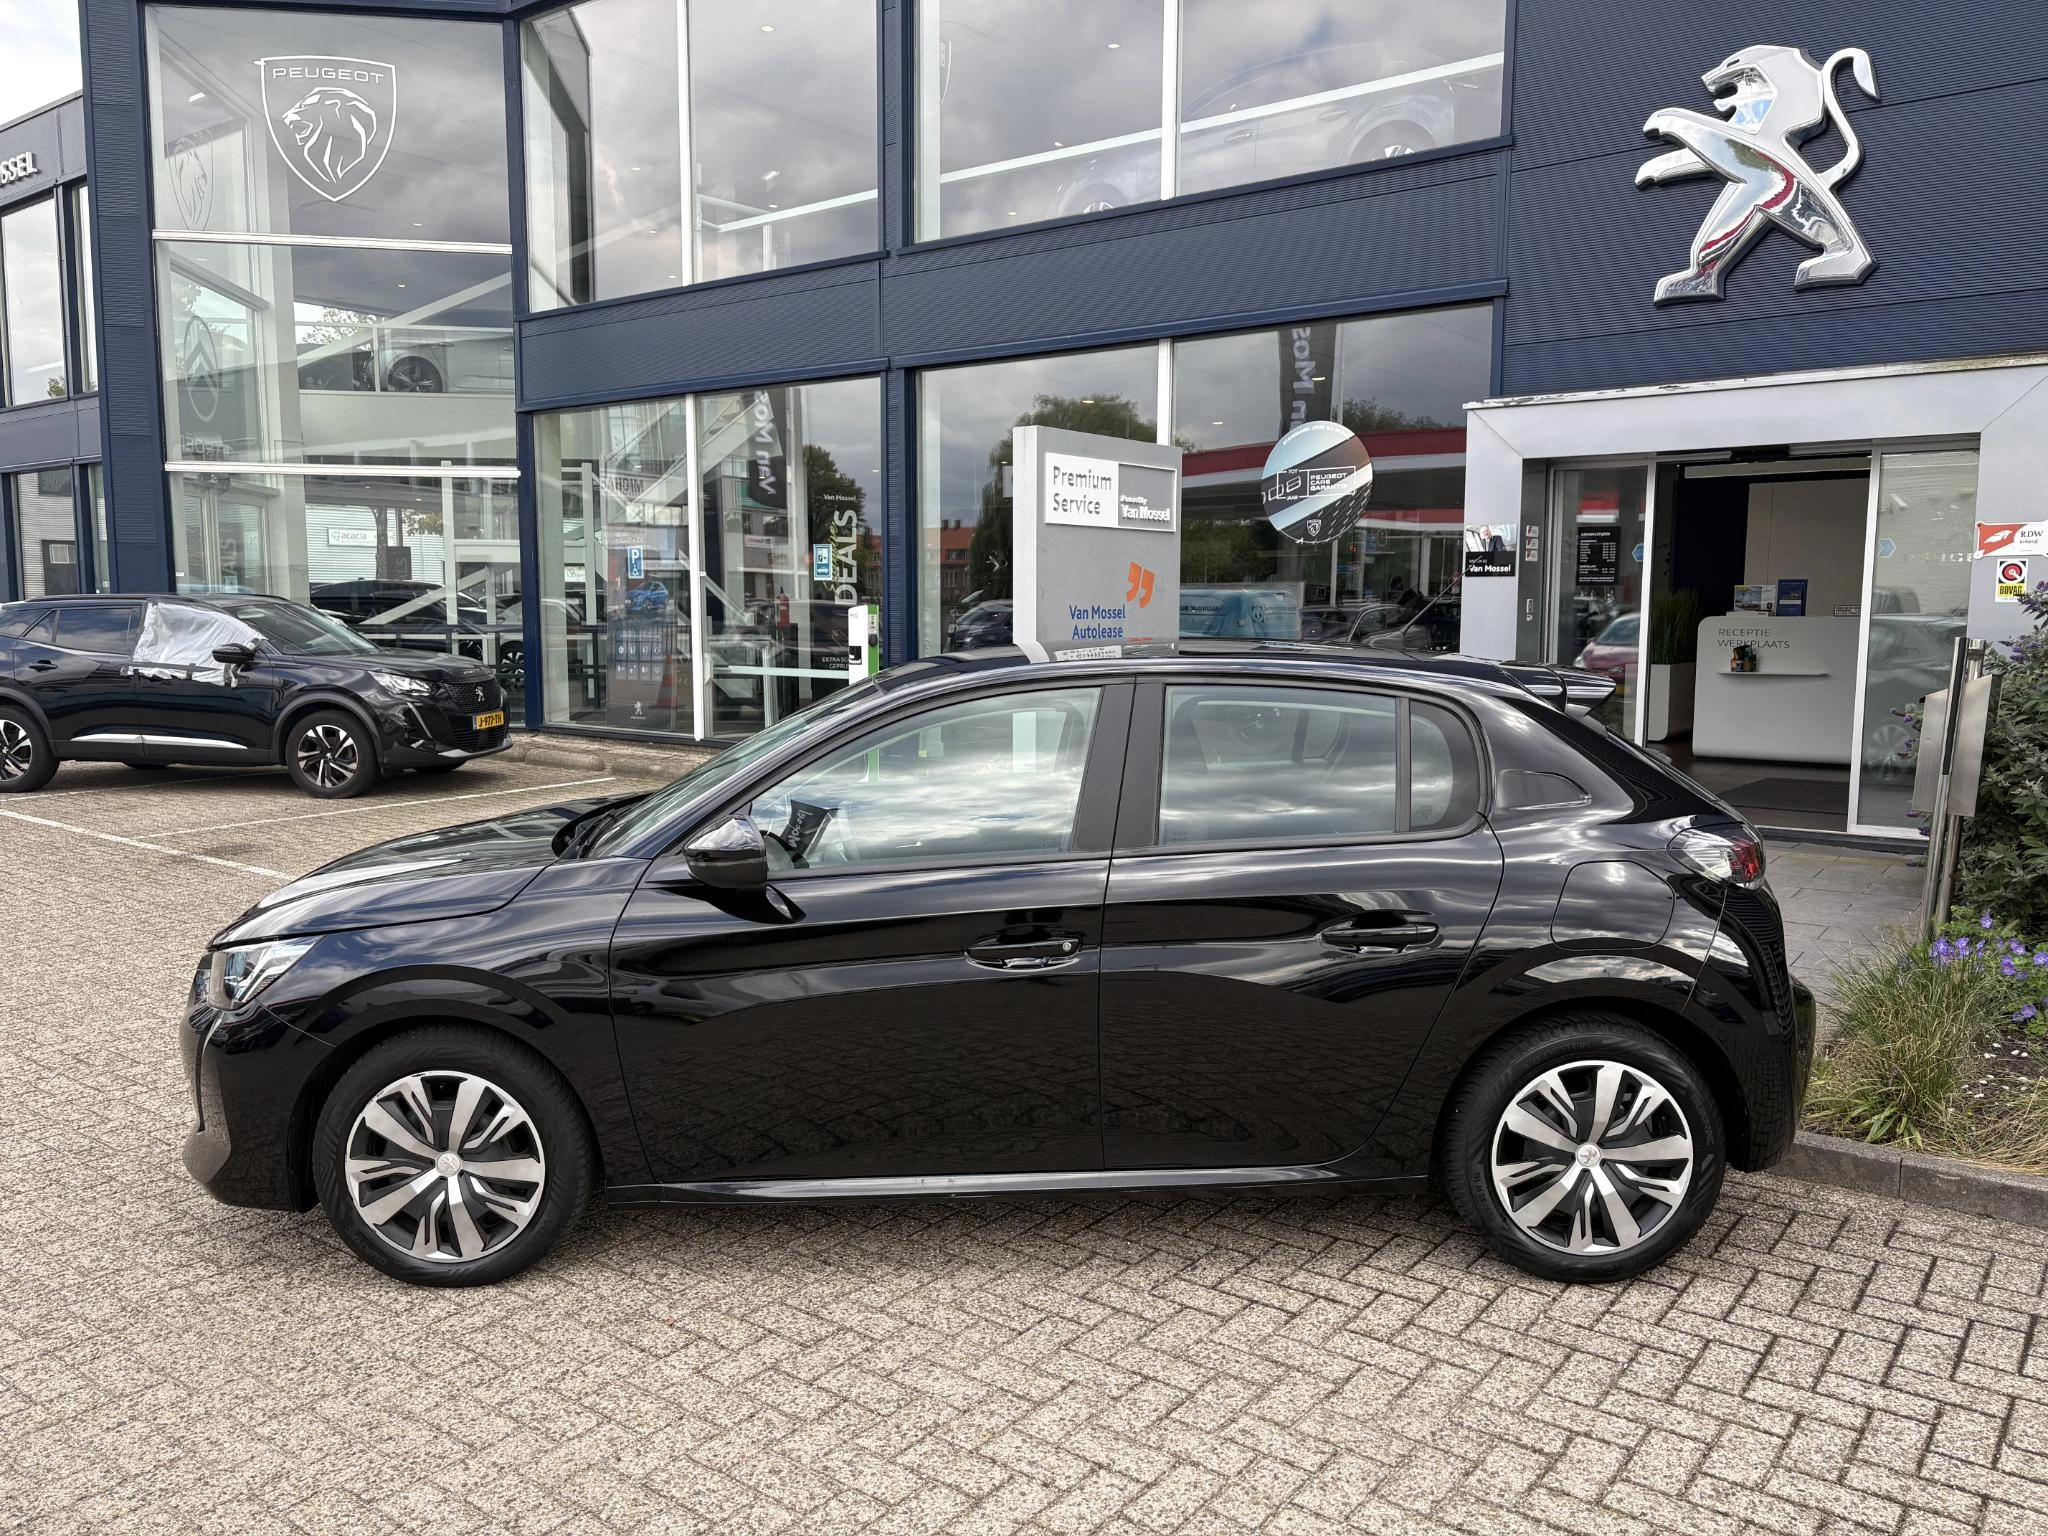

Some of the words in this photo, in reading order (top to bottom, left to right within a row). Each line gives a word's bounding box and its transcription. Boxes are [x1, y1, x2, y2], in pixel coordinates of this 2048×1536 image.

[272, 67, 384, 84] PEUGEOT
[1053, 466, 1112, 490] Premium
[1310, 472, 1348, 480] PEUGEOT
[1053, 493, 1101, 515] Service
[1121, 504, 1140, 518] Van
[1139, 506, 1170, 521] Mossel
[2020, 530, 2043, 538] RDW
[834, 509, 858, 605] DEALS
[1484, 564, 1511, 572] Mossel
[1999, 586, 2022, 595] BOVAG
[1069, 605, 1089, 619] Van
[1091, 604, 1126, 619] Mossel
[1072, 623, 1123, 640] Autolease
[1718, 628, 1770, 637] RECEPTIE
[1717, 639, 1791, 649] WERKPLAATS
